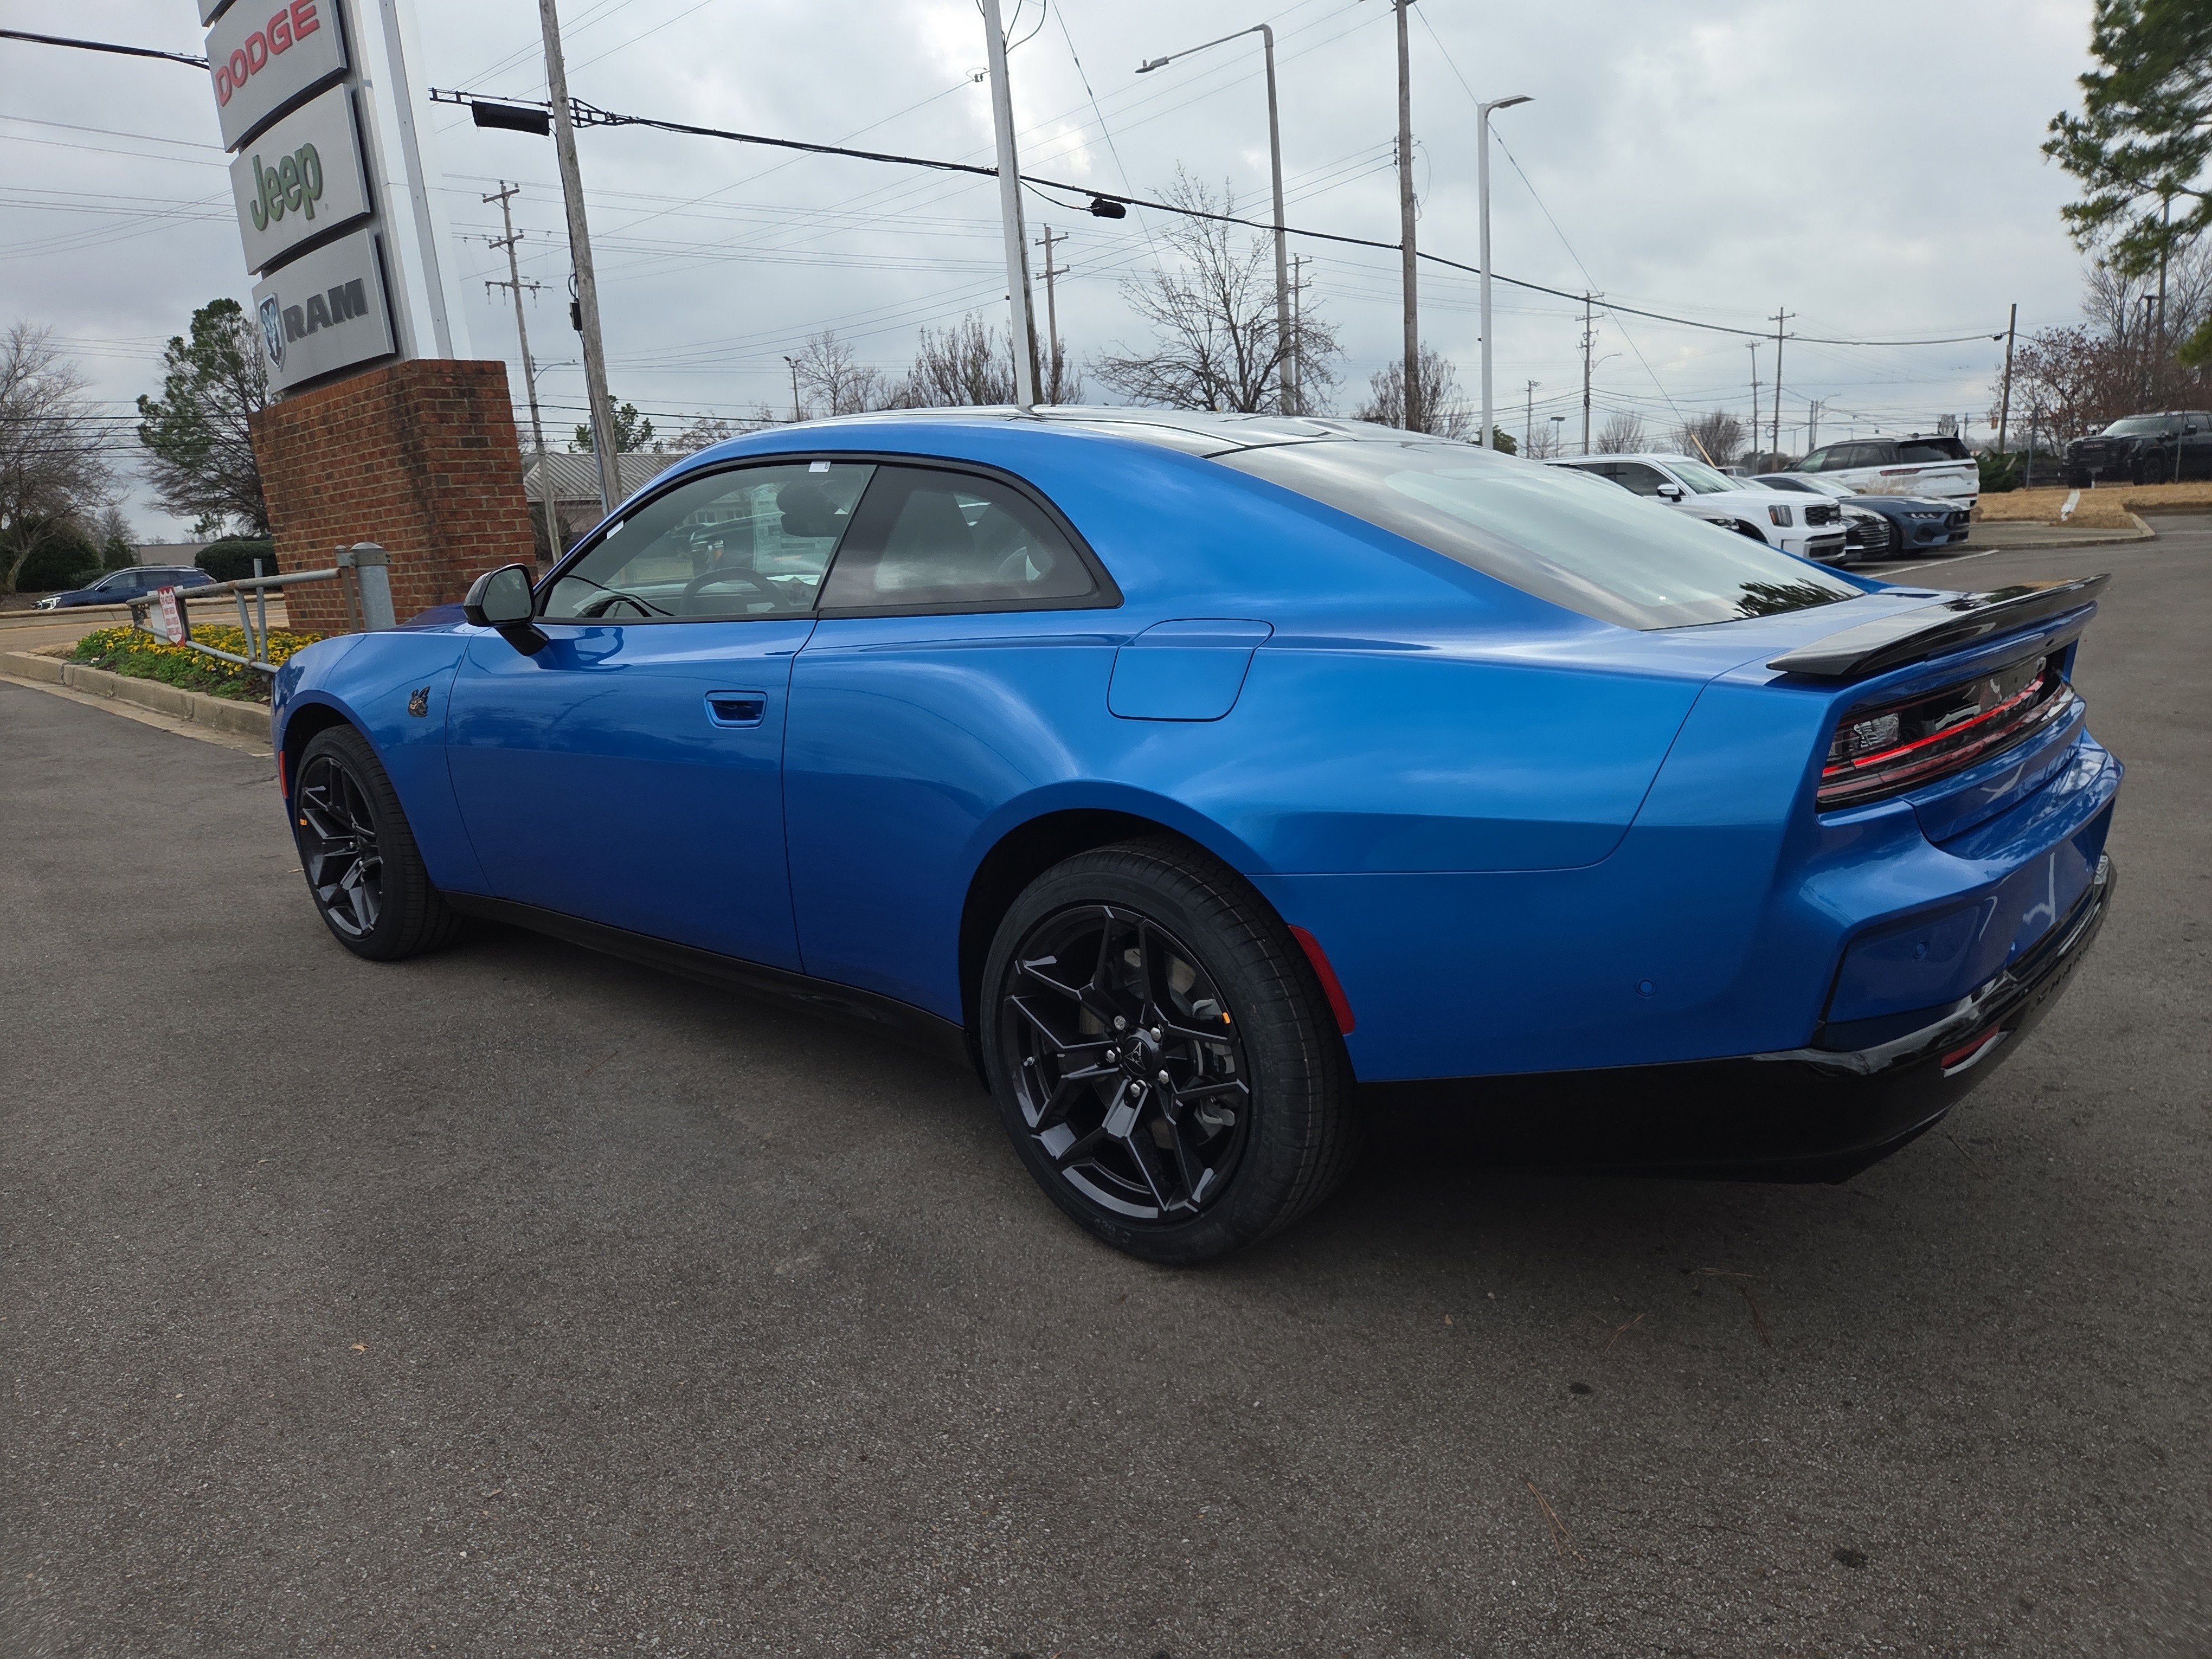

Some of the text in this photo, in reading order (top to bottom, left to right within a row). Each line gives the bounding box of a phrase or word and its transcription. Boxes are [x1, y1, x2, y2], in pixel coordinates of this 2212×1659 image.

[215, 0, 320, 107] DODGE
[250, 143, 323, 232] Jeep
[282, 278, 369, 344] RAM
